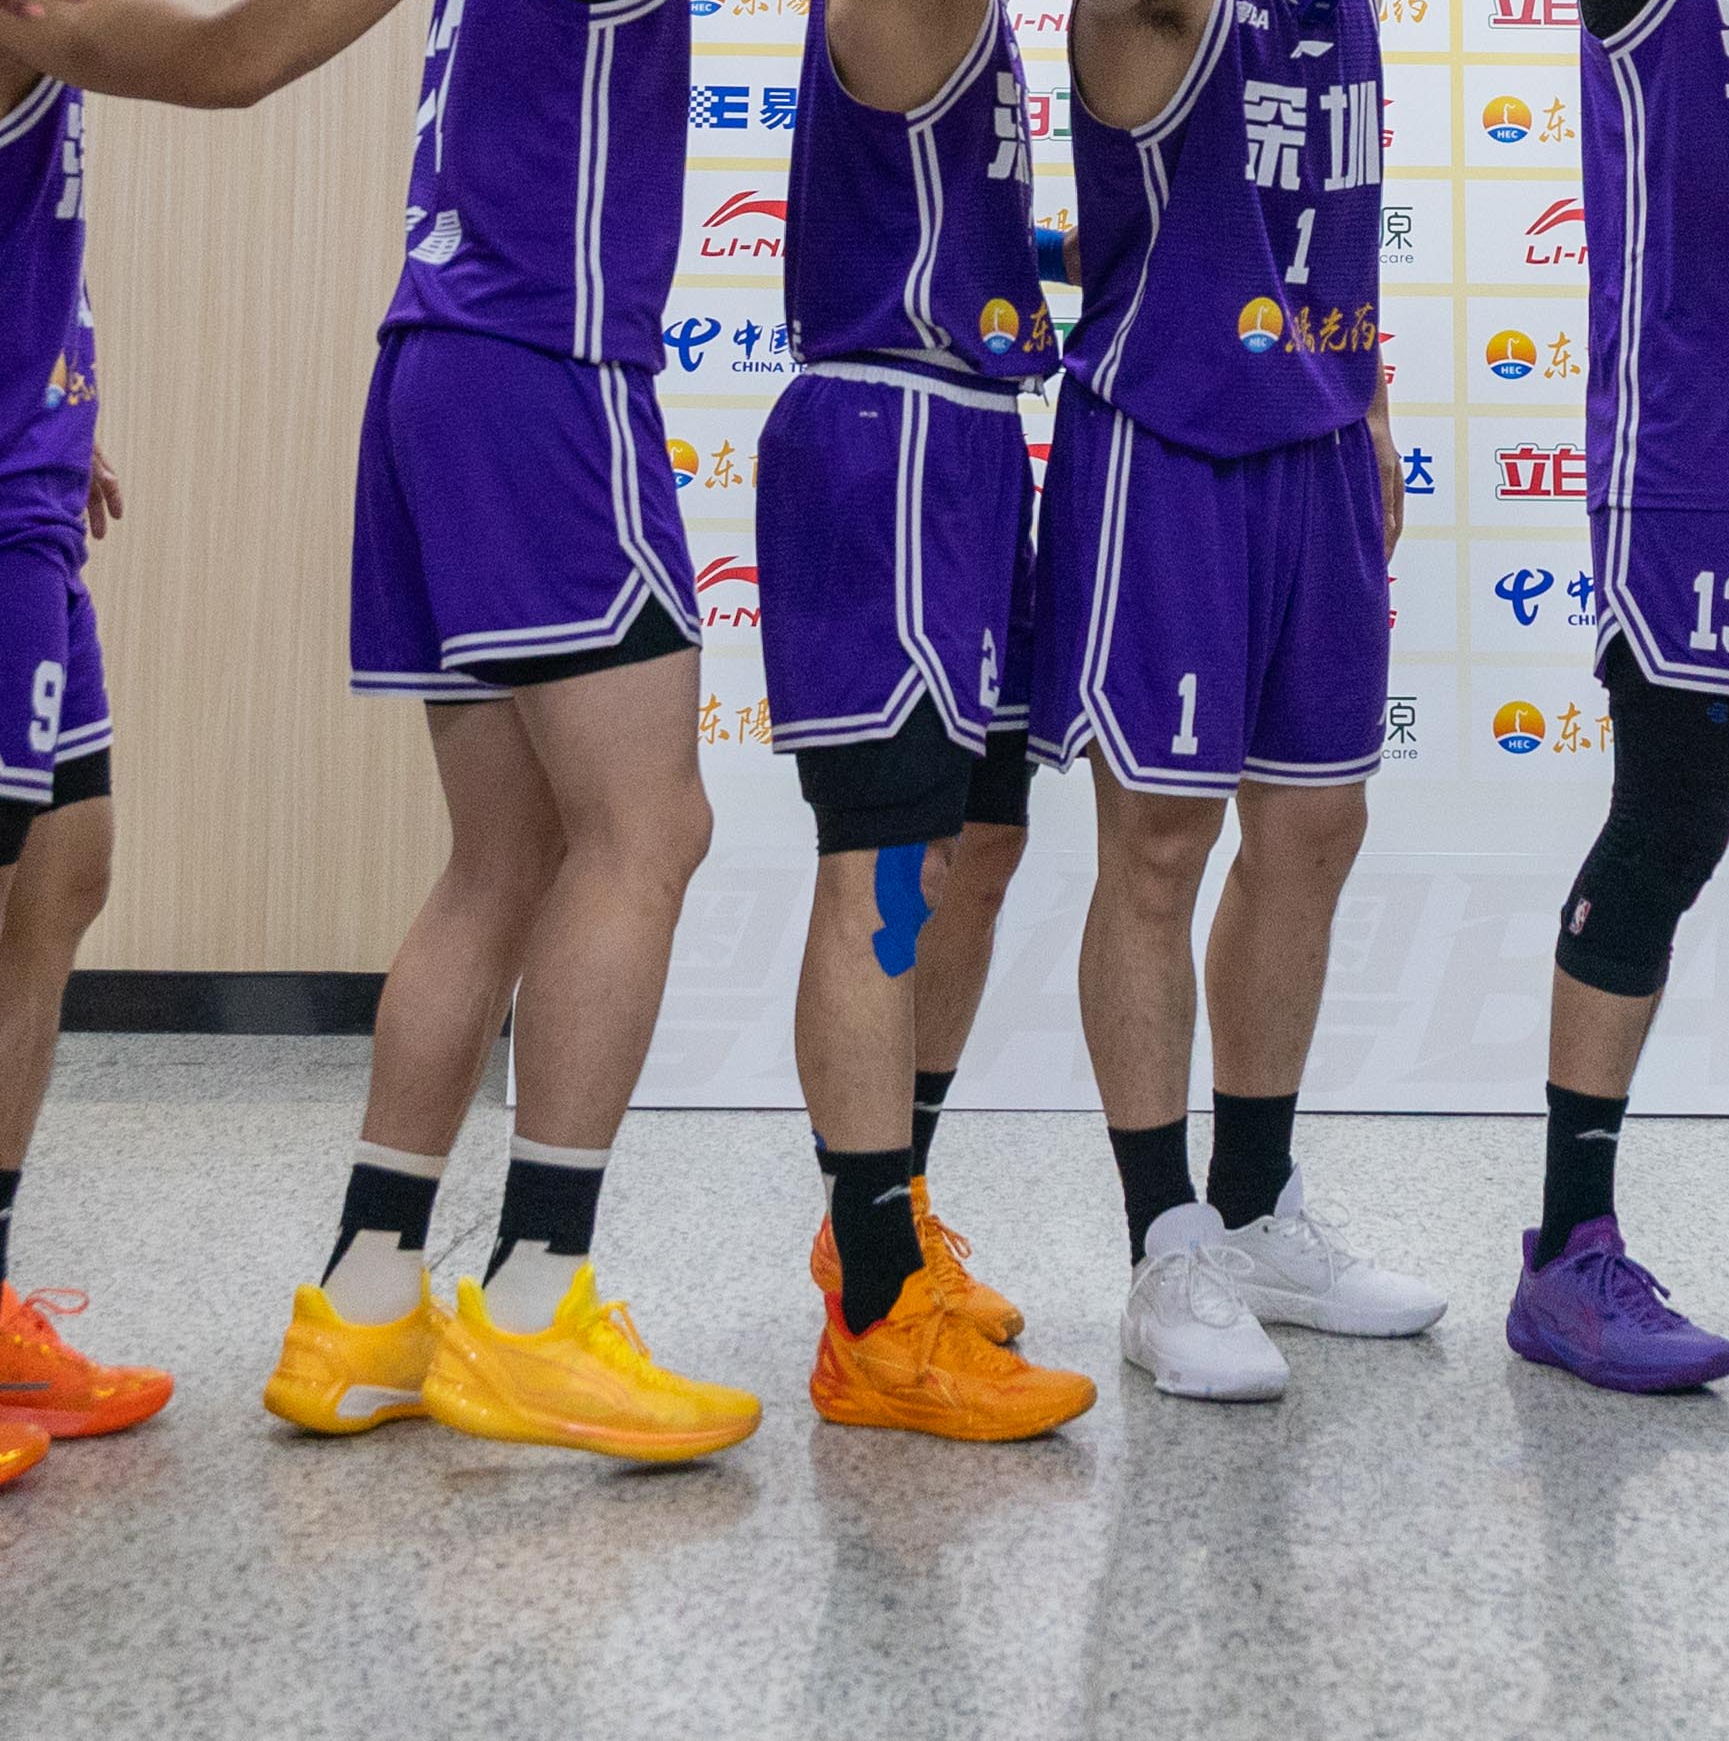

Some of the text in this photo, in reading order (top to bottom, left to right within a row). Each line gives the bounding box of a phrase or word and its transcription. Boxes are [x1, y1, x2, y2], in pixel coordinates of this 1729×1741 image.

[1497, 130, 1518, 139] HEC
[1284, 208, 1316, 285] 1
[732, 361, 784, 373] CHINA
[1501, 365, 1522, 375] HEC
[1171, 672, 1199, 756] 1
[1508, 740, 1531, 750] HEC
